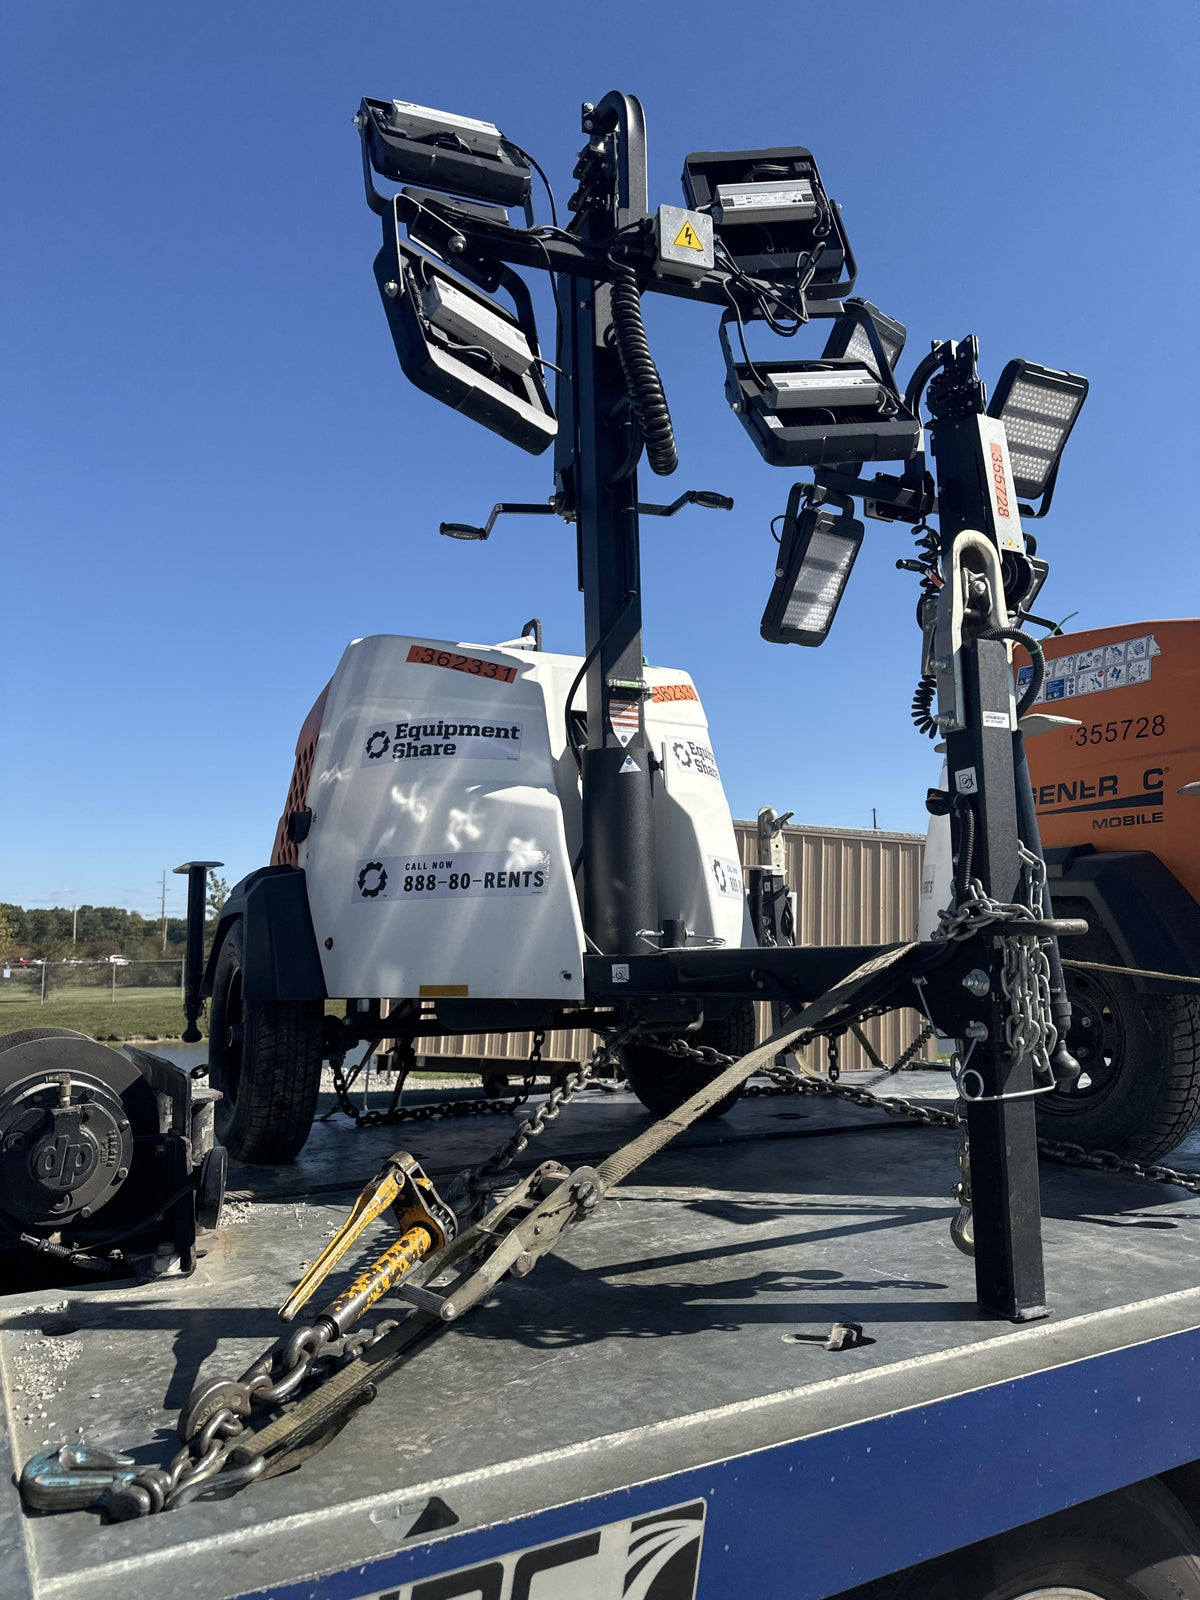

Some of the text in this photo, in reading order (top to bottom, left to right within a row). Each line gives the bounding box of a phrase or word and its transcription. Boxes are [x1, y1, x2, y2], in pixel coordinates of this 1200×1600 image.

[991, 452, 1010, 518] 355728
[420, 647, 513, 681] 362331
[394, 721, 520, 741] Equipment
[1075, 714, 1166, 747] 355728
[392, 742, 457, 759] Share
[1092, 812, 1164, 830] MOBILE
[405, 861, 453, 871] CALL NOW
[403, 870, 545, 892] 888-80-RENTS
[33, 1134, 94, 1187] dp
